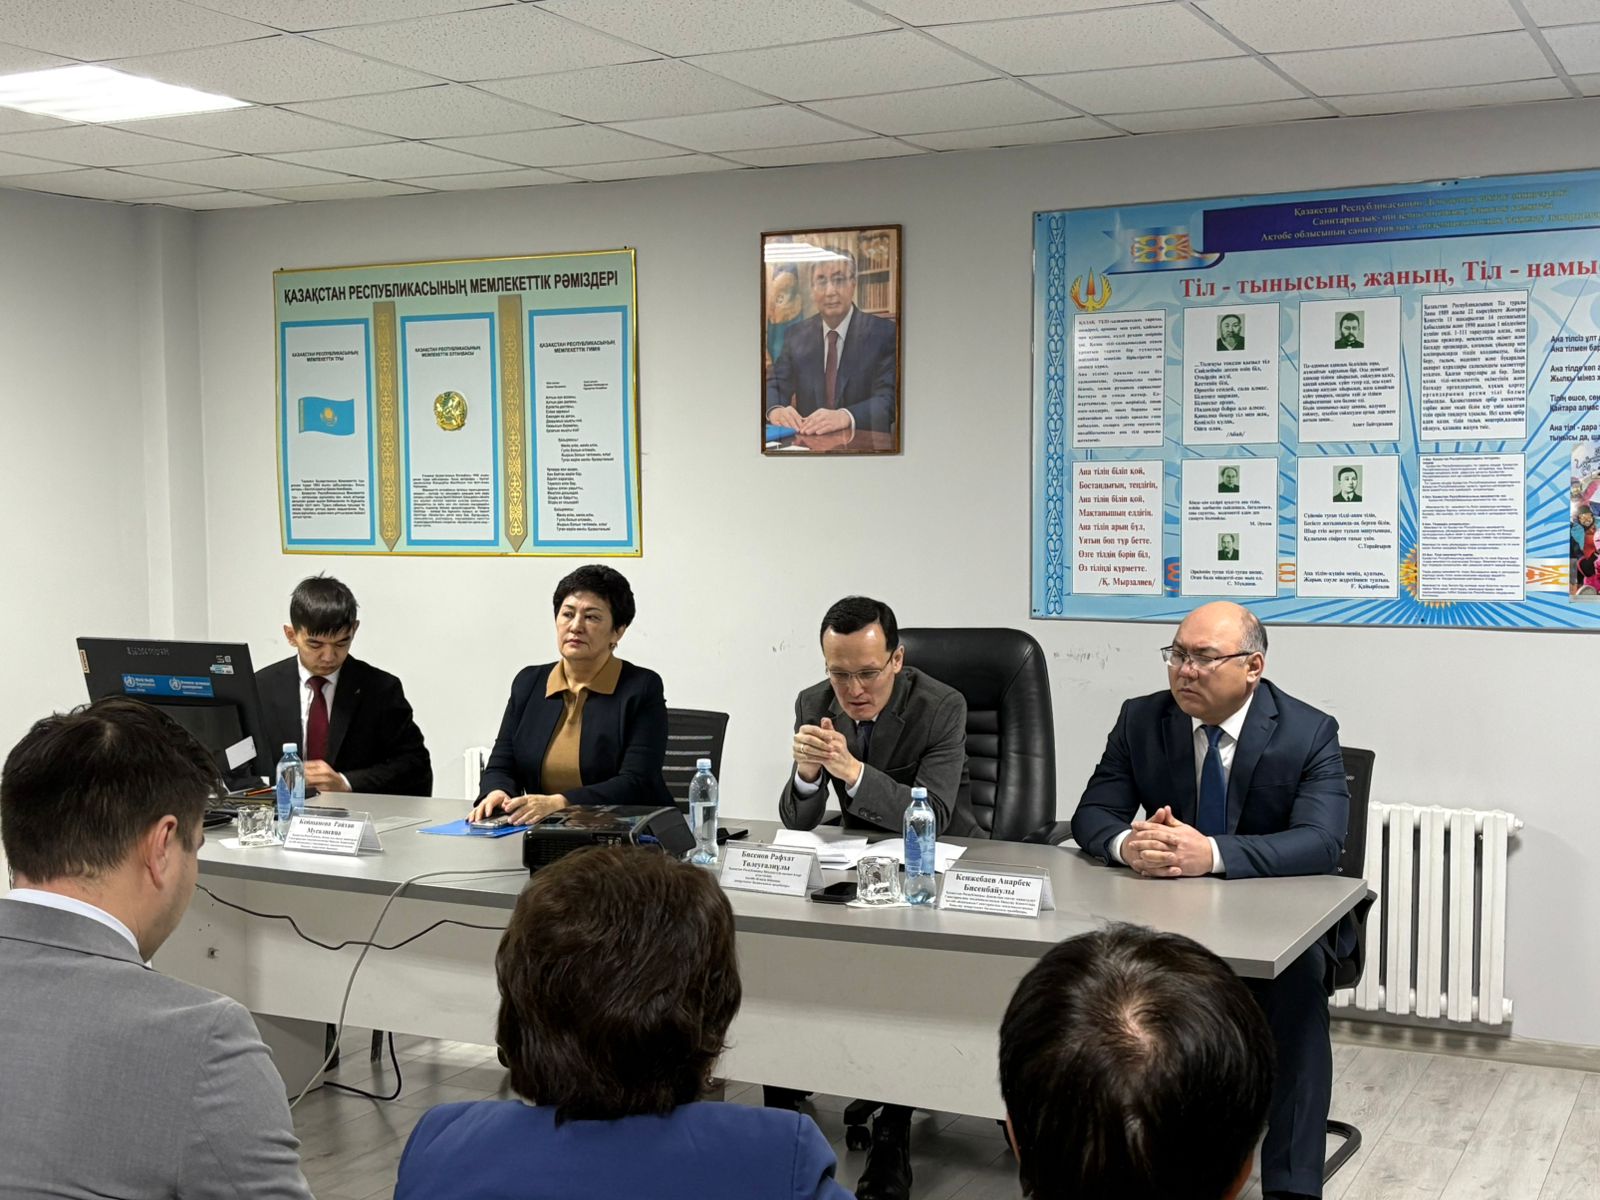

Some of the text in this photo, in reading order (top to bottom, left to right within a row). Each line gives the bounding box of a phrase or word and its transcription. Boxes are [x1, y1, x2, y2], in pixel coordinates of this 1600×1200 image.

[284, 270, 618, 305] ҚАЗАҚСТАН РЕСПУБЛИКАСЫНЫҢ МЕМЛЕКЕТТІК РӘМІЗДЕРІ
[1179, 278, 1216, 298] Тіл
[1236, 273, 1357, 295] тынысың,
[1363, 267, 1455, 288] жаның,
[1462, 260, 1503, 282] Тіл
[1527, 259, 1600, 278] намы
